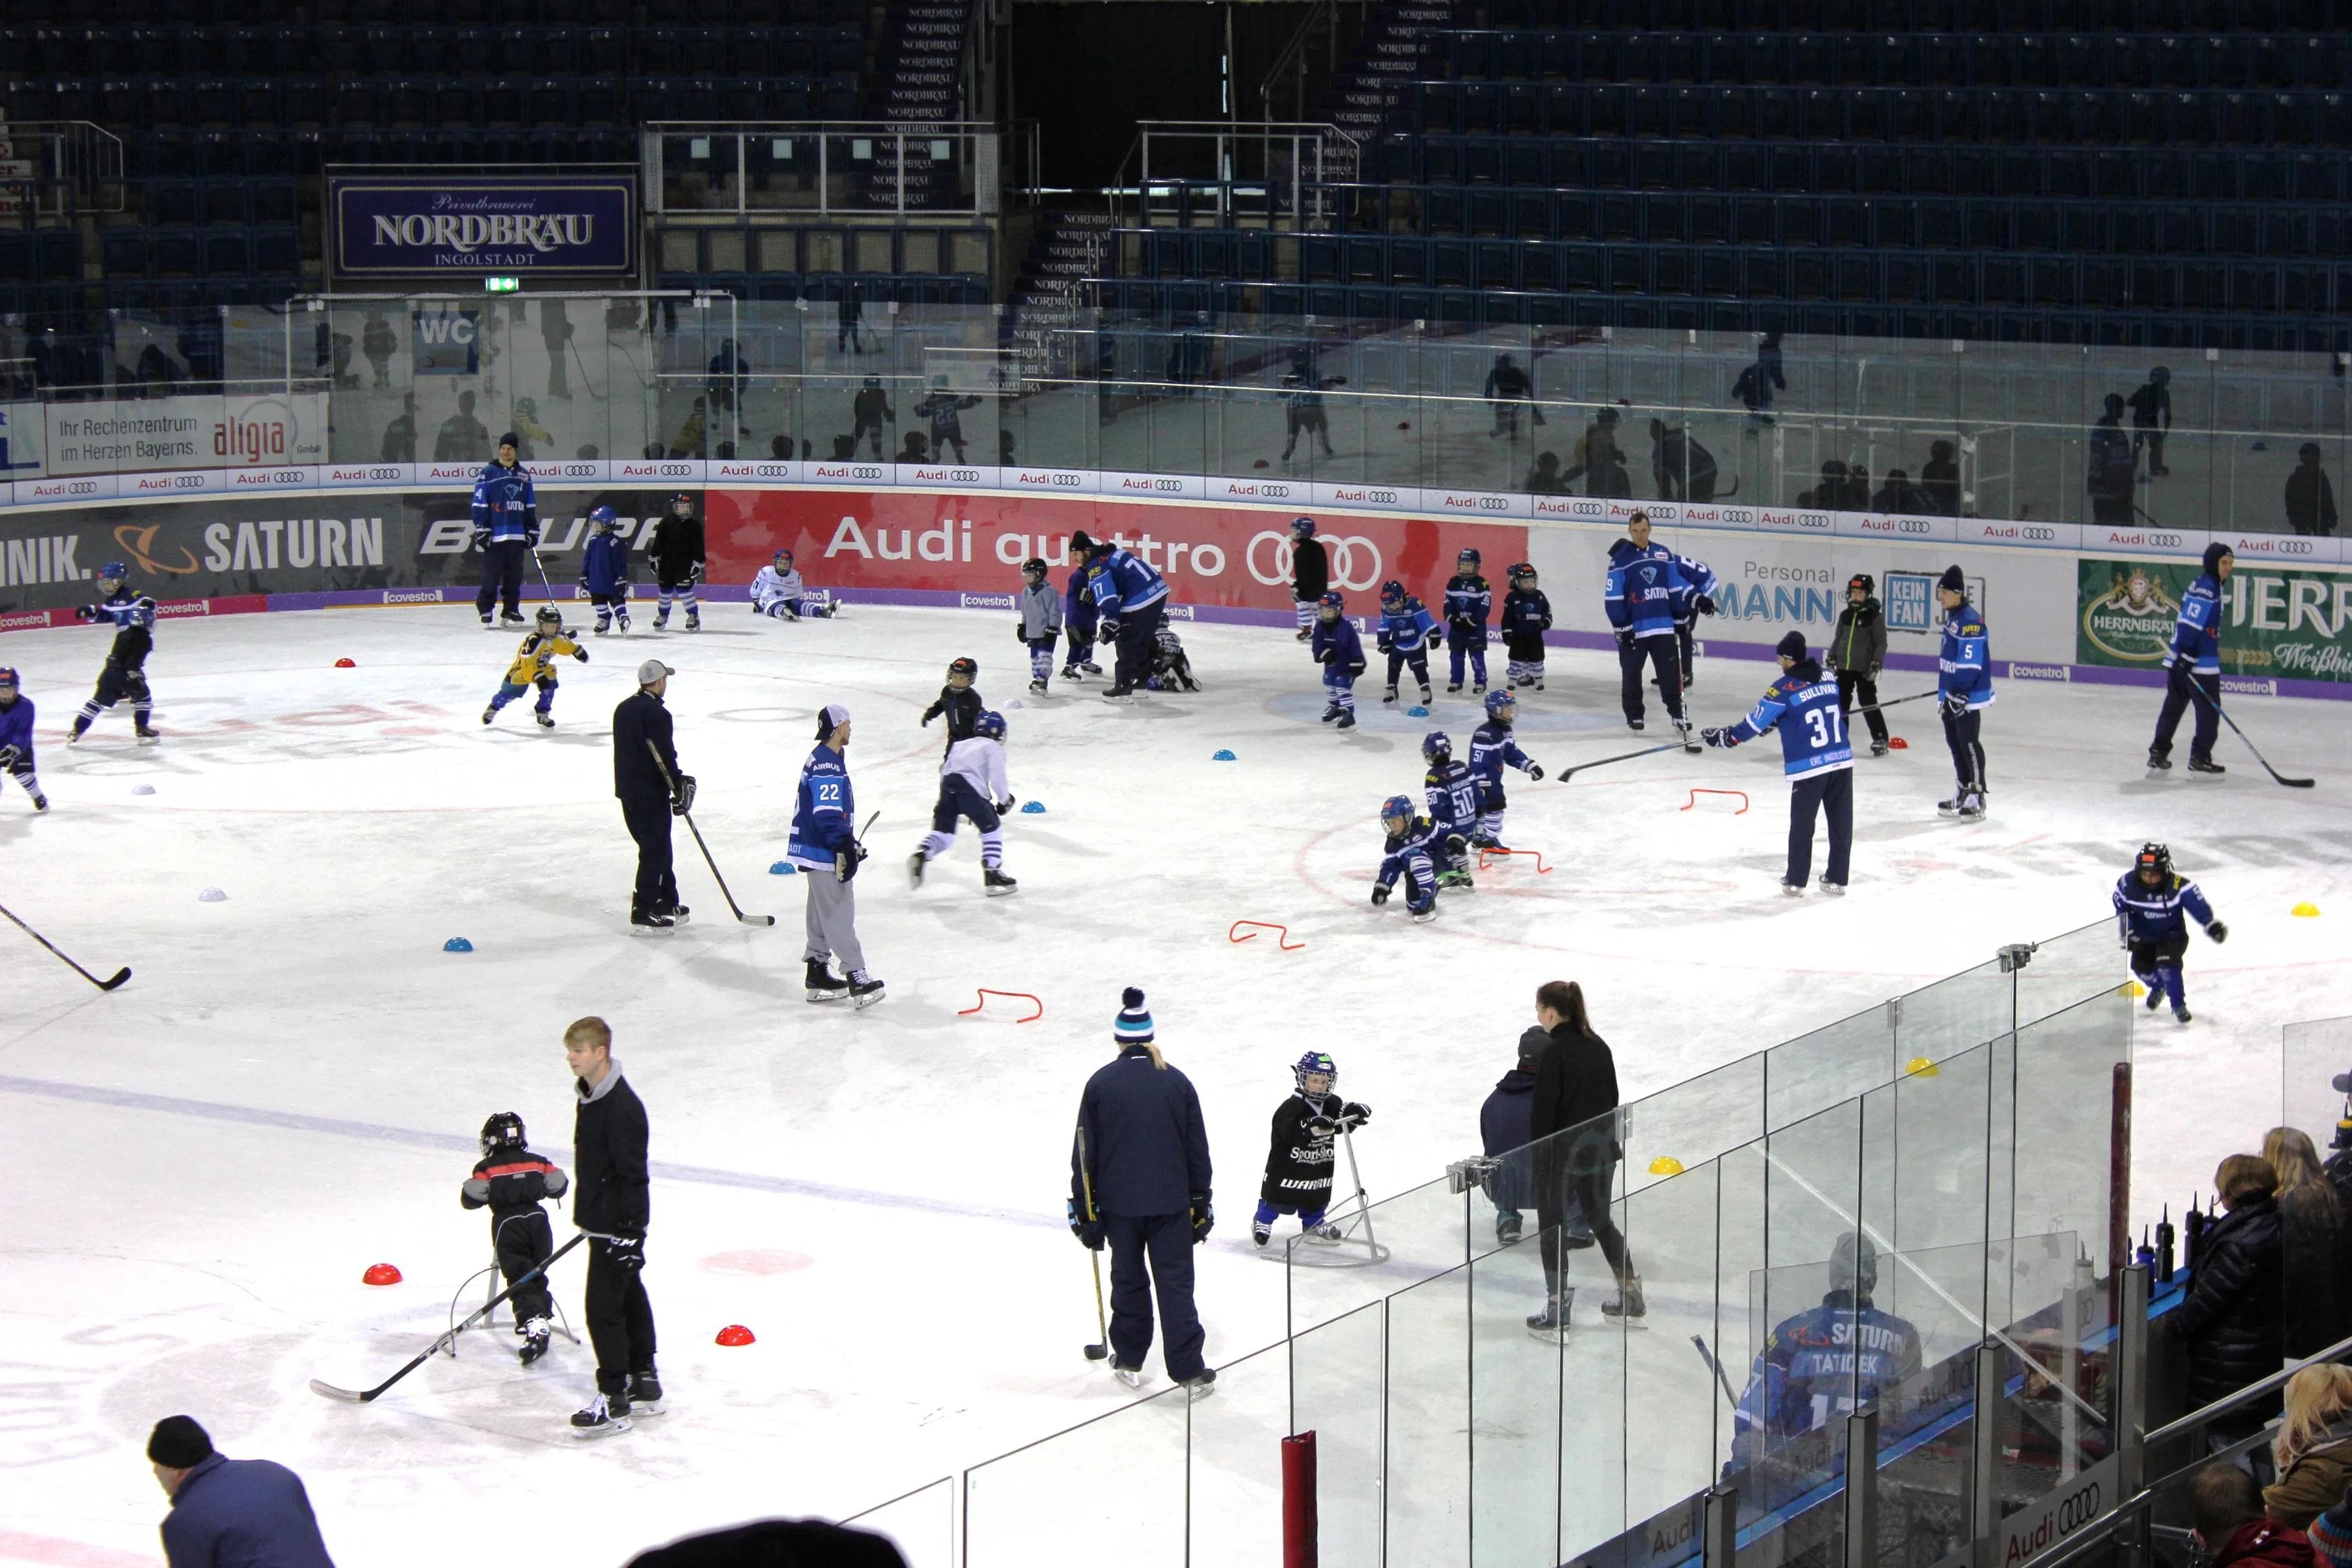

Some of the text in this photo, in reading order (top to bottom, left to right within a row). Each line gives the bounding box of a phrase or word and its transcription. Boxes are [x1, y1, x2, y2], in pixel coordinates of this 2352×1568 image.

[372, 213, 595, 252] NORDBRÄU
[435, 253, 536, 265] INGOLSTADT
[419, 318, 474, 344] WC
[60, 416, 197, 437] Ihr Rechenzentrum
[61, 440, 197, 461] im Herzen Bayerns.
[297, 445, 321, 453] GmbH
[333, 470, 366, 480] Audi
[431, 468, 464, 478] Audi
[528, 466, 561, 476] Audi
[623, 465, 657, 475] Audi
[721, 465, 754, 475] Audi
[817, 467, 849, 477] Audi
[916, 470, 947, 480] Audi
[139, 478, 171, 489] Audi
[237, 474, 270, 484] Audi
[1019, 473, 1050, 484] Audi
[1123, 478, 1152, 489] Audi
[35, 485, 65, 496] Audi
[475, 489, 483, 500] 4
[1228, 484, 1258, 495] Audi
[1335, 490, 1365, 501] Audi
[1445, 497, 1477, 508] Audi
[1538, 502, 1569, 513] Audi
[1610, 505, 1643, 516] Audi
[1686, 510, 1719, 520] Audi
[1761, 513, 1795, 524] Audi
[1861, 519, 1895, 531] Audi
[1984, 525, 2018, 538] Audi
[2109, 532, 2144, 544] Audi
[204, 517, 384, 572] SATURN
[824, 516, 972, 563] Audi
[995, 532, 1226, 576] quttro
[2238, 539, 2274, 551] Audi
[0, 534, 91, 587] NIK.
[1744, 561, 1835, 583] Personal
[1892, 581, 1925, 600] KEIN
[389, 591, 436, 602] covestro
[966, 596, 1009, 607] covestro
[156, 602, 203, 613] covestro
[1164, 606, 1188, 617] estro
[1892, 602, 1925, 625] FAN
[1, 615, 44, 627] covestro
[1965, 644, 1973, 659] 5
[2014, 666, 2065, 679] covestro
[2221, 679, 2269, 693] covestro
[1805, 704, 1842, 748] 37
[1473, 750, 1484, 763] 51
[812, 761, 841, 772] AIRBUS
[819, 784, 840, 800] 22
[1450, 785, 1476, 818] 50
[1831, 1322, 1907, 1357] SATURN
[1651, 1511, 1697, 1559] Audi
[2006, 1511, 2053, 1567] Audi
